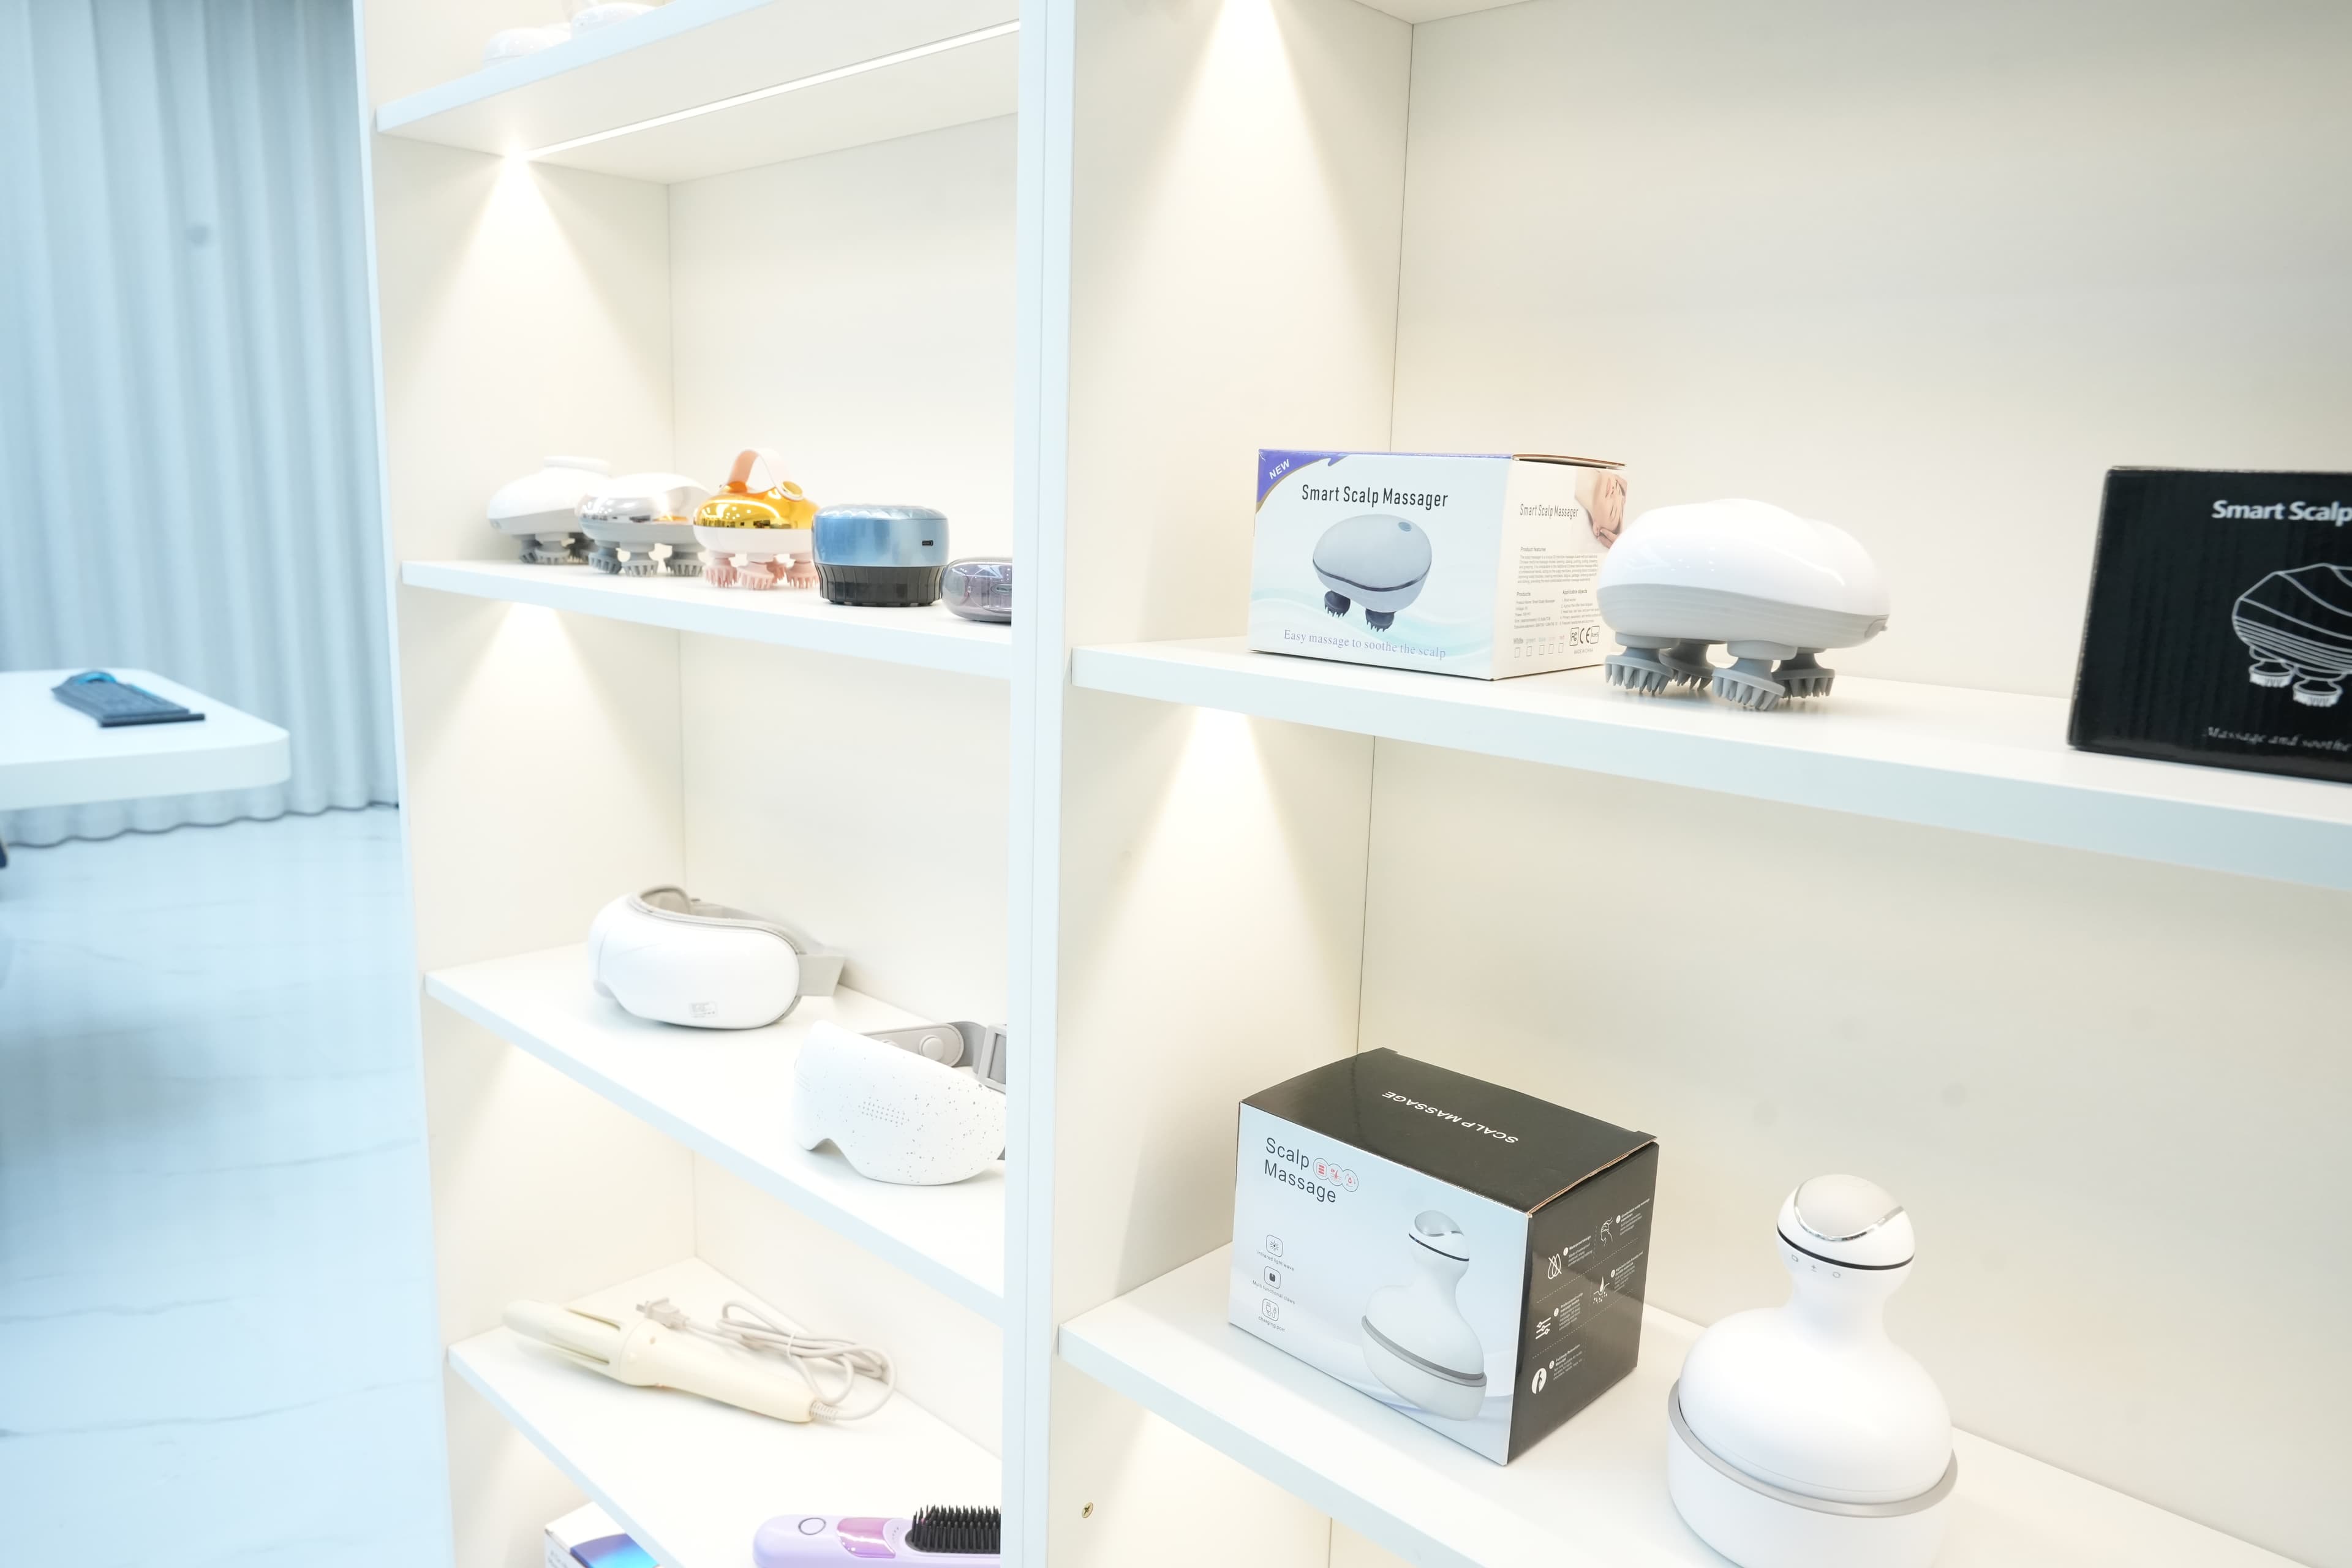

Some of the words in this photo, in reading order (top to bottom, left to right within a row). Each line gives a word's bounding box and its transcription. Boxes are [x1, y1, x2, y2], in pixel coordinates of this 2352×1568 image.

[1269, 459, 1290, 480] NEW
[1302, 484, 1340, 502] Smart
[1343, 486, 1379, 508] Scalp
[1382, 488, 1449, 511] Massager
[1520, 503, 1537, 516] Smart
[1538, 504, 1553, 519] Scalp
[1554, 505, 1578, 520] Massager
[2211, 499, 2285, 520] Smart
[2288, 500, 2352, 527] Scalp
[1284, 629, 1305, 643] Easy
[1309, 635, 1349, 649] massage
[1352, 638, 1362, 648] to
[1365, 641, 1397, 652] soothe
[1400, 644, 1415, 655] the
[1418, 646, 1446, 661] scalp
[1381, 1091, 1463, 1123] MASSAGE
[1461, 1121, 1519, 1144] SCALP
[1265, 1137, 1310, 1170] Scalp
[1264, 1159, 1336, 1203] Massage
[1258, 1316, 1276, 1329] charging
